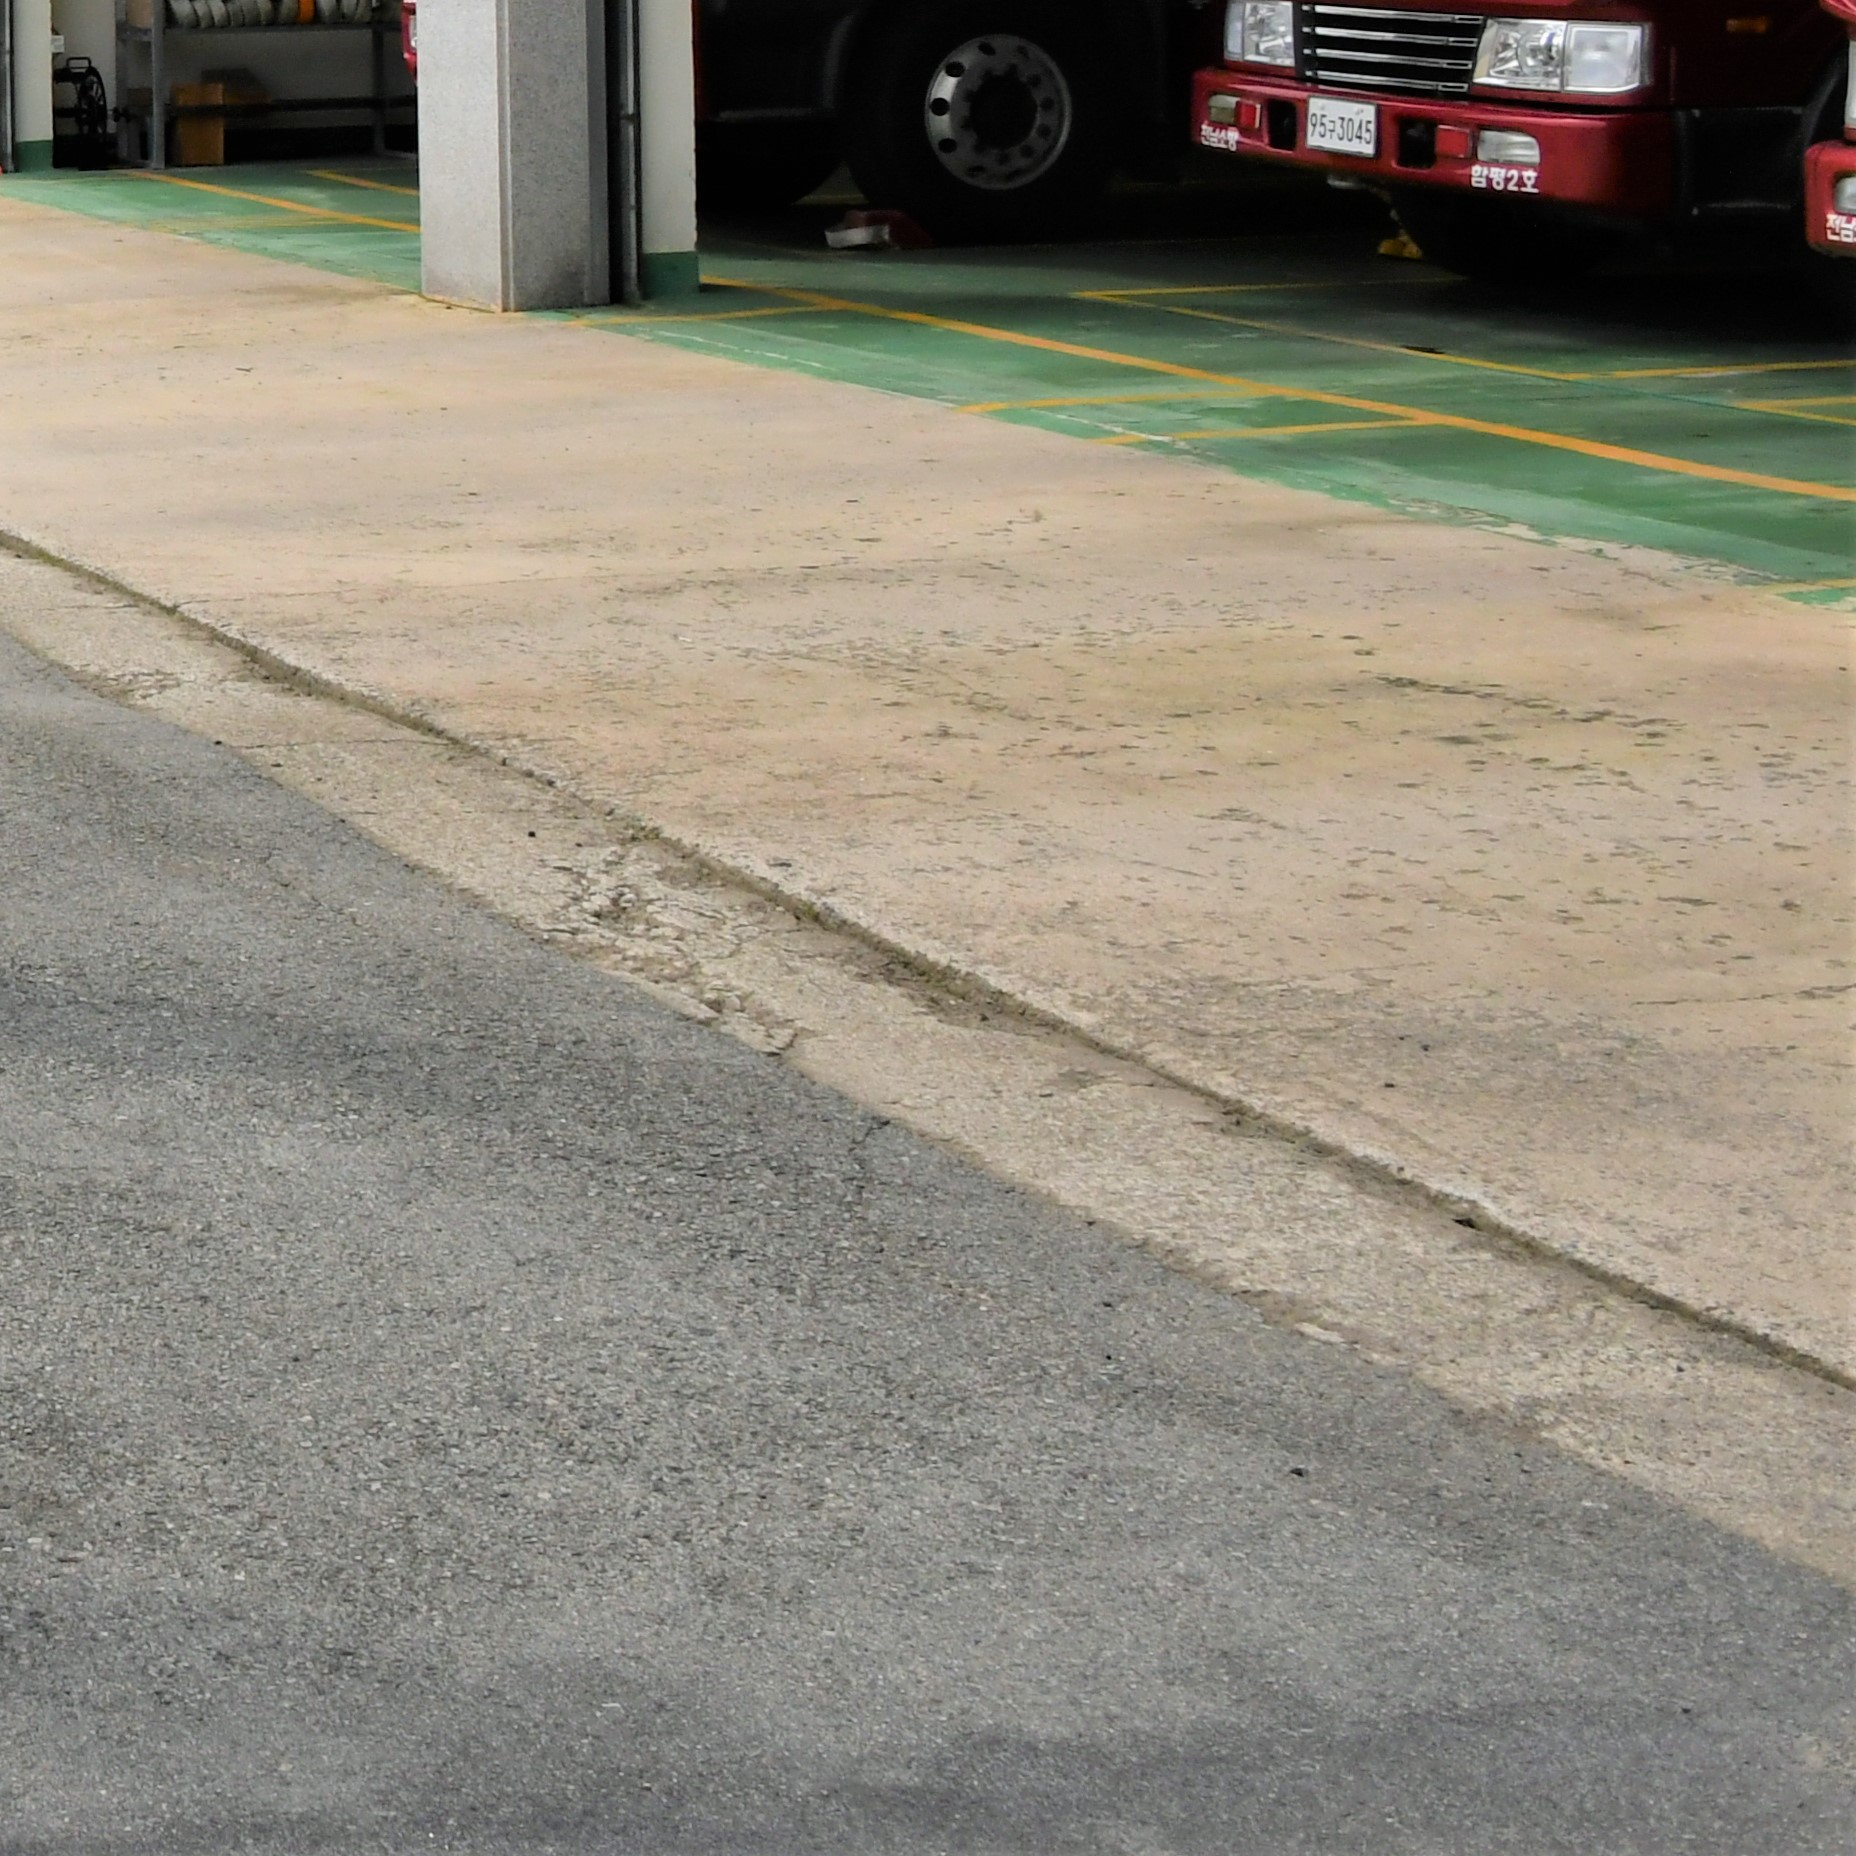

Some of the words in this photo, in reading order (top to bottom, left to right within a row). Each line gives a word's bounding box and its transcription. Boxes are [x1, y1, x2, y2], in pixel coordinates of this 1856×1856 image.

[1310, 112, 1374, 145] 95구3045
[1471, 164, 1540, 193] 함평2호
[1826, 213, 1856, 243] 전남
